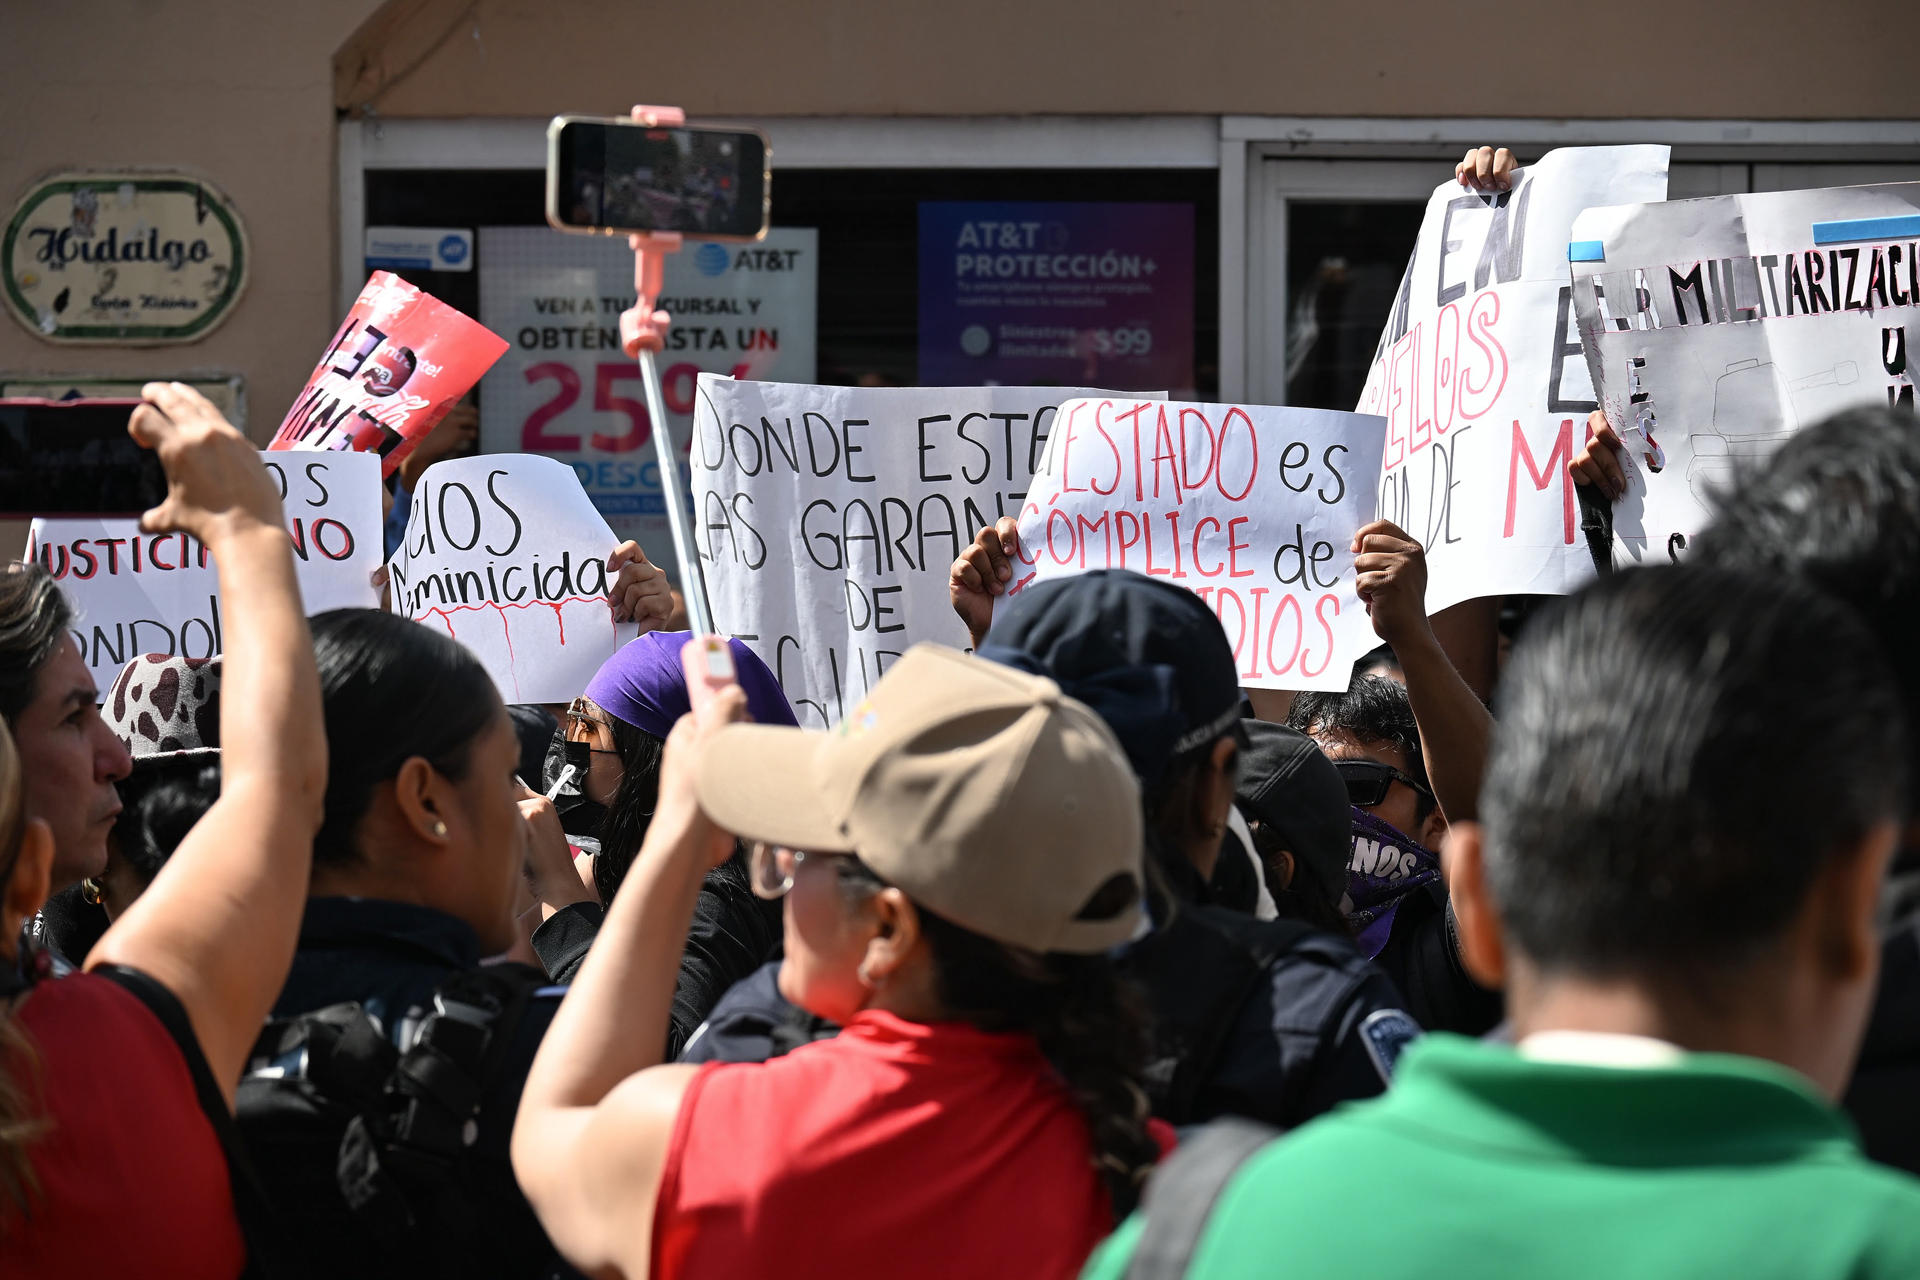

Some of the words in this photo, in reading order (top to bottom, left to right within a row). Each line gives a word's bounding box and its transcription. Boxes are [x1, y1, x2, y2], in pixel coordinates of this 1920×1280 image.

[28, 226, 213, 271] Hidalgo
[957, 222, 1041, 249] AT&T
[734, 250, 801, 271] AT&T
[956, 249, 1157, 278] PROTECCIÓN+
[534, 297, 574, 315] VEN
[579, 297, 595, 314] A
[656, 298, 742, 316] CURSAL
[748, 298, 761, 315] Y
[519, 322, 620, 351] OBTÉN
[664, 329, 728, 351] STA
[738, 329, 779, 351] UN
[697, 381, 877, 483] DONDE
[1063, 401, 1258, 505] ESTADO
[1279, 441, 1349, 505] es
[1425, 425, 1472, 556] DE
[701, 490, 767, 571] AS
[1016, 493, 1255, 579] CÓMPLICE
[1273, 523, 1340, 592] de
[844, 579, 905, 634] DE
[1345, 835, 1417, 881] NOS
